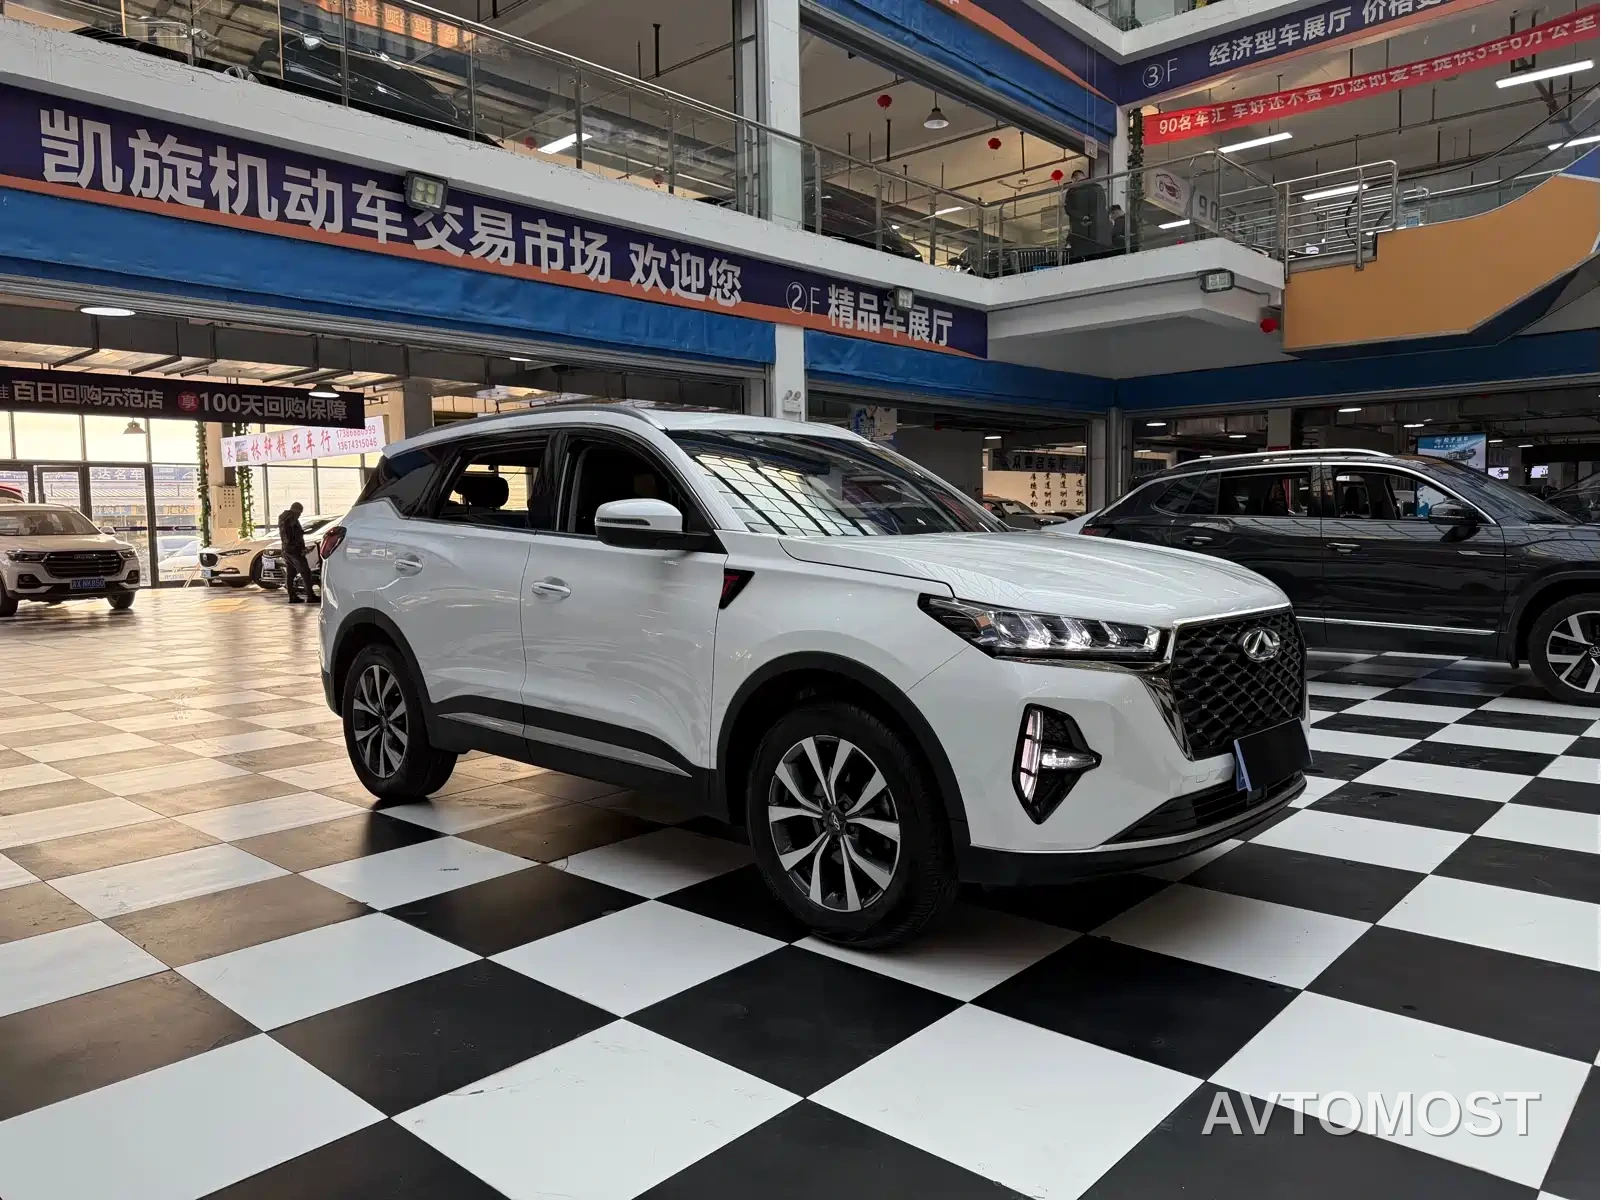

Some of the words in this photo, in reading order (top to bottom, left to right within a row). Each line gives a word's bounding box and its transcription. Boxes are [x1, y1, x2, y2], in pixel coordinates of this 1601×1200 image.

[1208, 7, 1351, 67] 经济型车展厅
[1159, 106, 1227, 134] 90名车汇
[40, 109, 611, 283] 凯旋机动车交易市场
[629, 242, 742, 307] 欢迎您
[828, 284, 953, 346] 精品车展厅
[12, 380, 163, 409] 百日回购示范店
[200, 392, 347, 421] 100天回购保障
